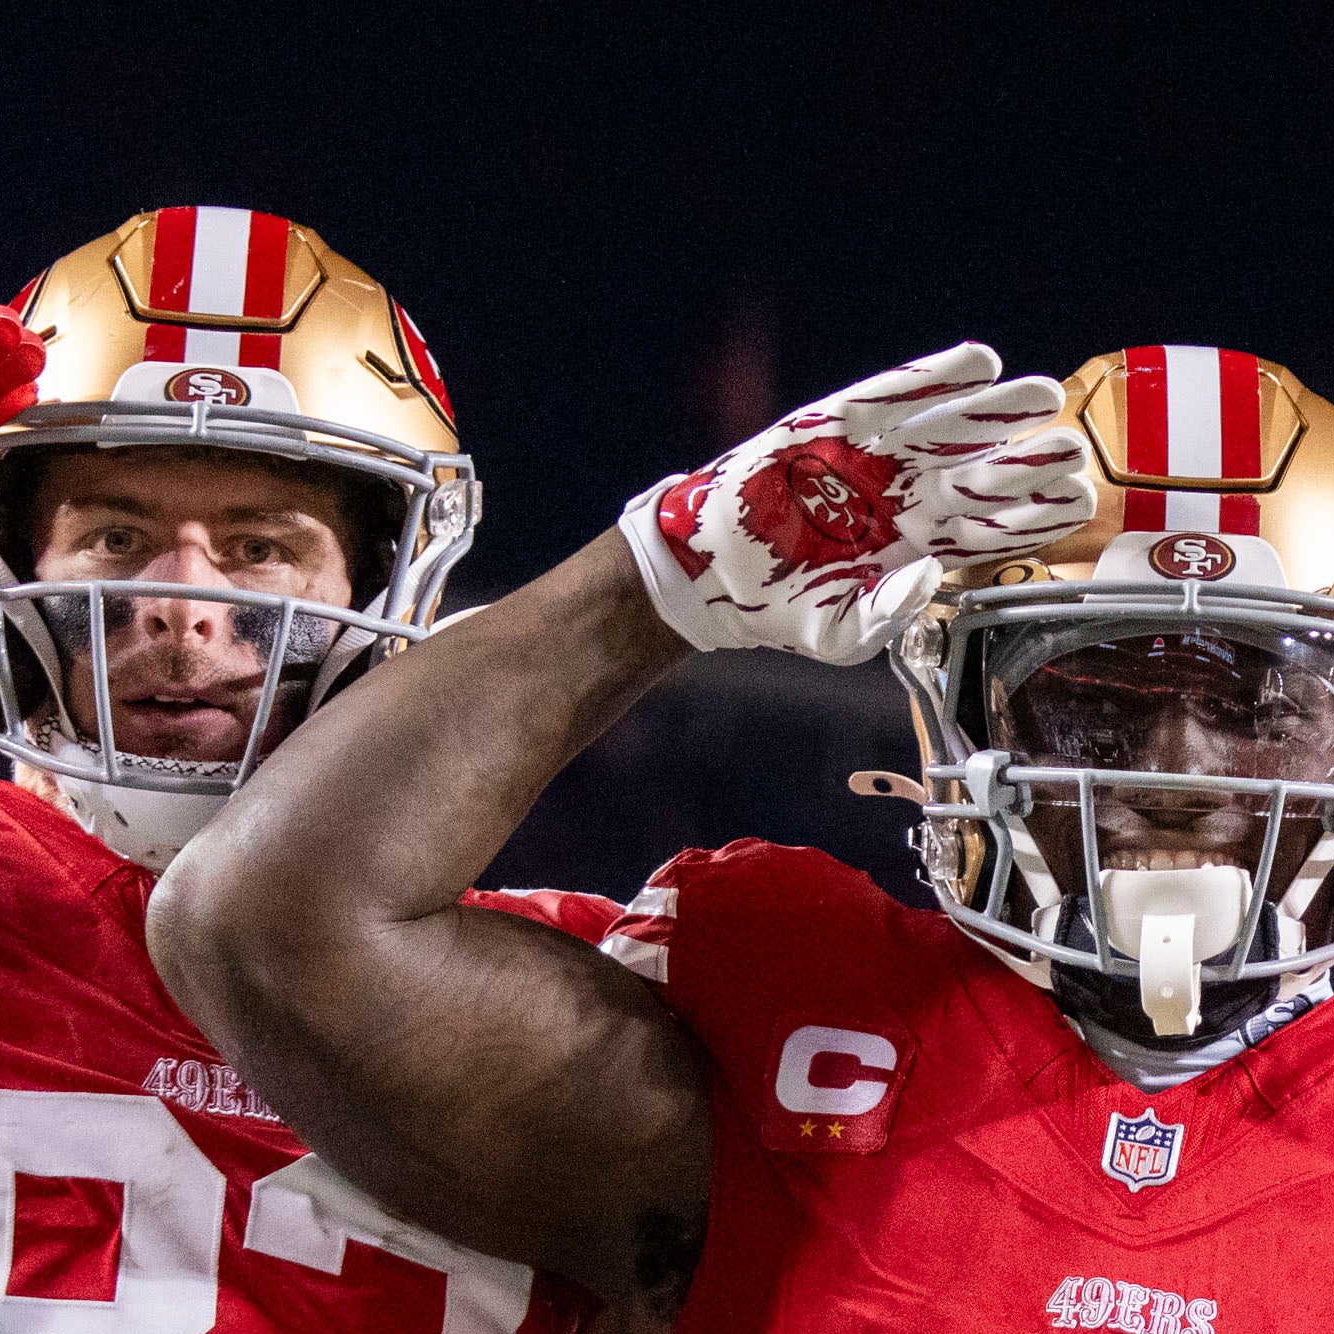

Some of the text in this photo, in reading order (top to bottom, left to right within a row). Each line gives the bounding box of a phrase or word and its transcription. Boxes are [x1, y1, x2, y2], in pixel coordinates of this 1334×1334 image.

[188, 373, 237, 406] SF
[1173, 538, 1222, 576] SF
[775, 1025, 897, 1116] C
[142, 1057, 281, 1124] 49E
[1115, 1142, 1163, 1175] NFL
